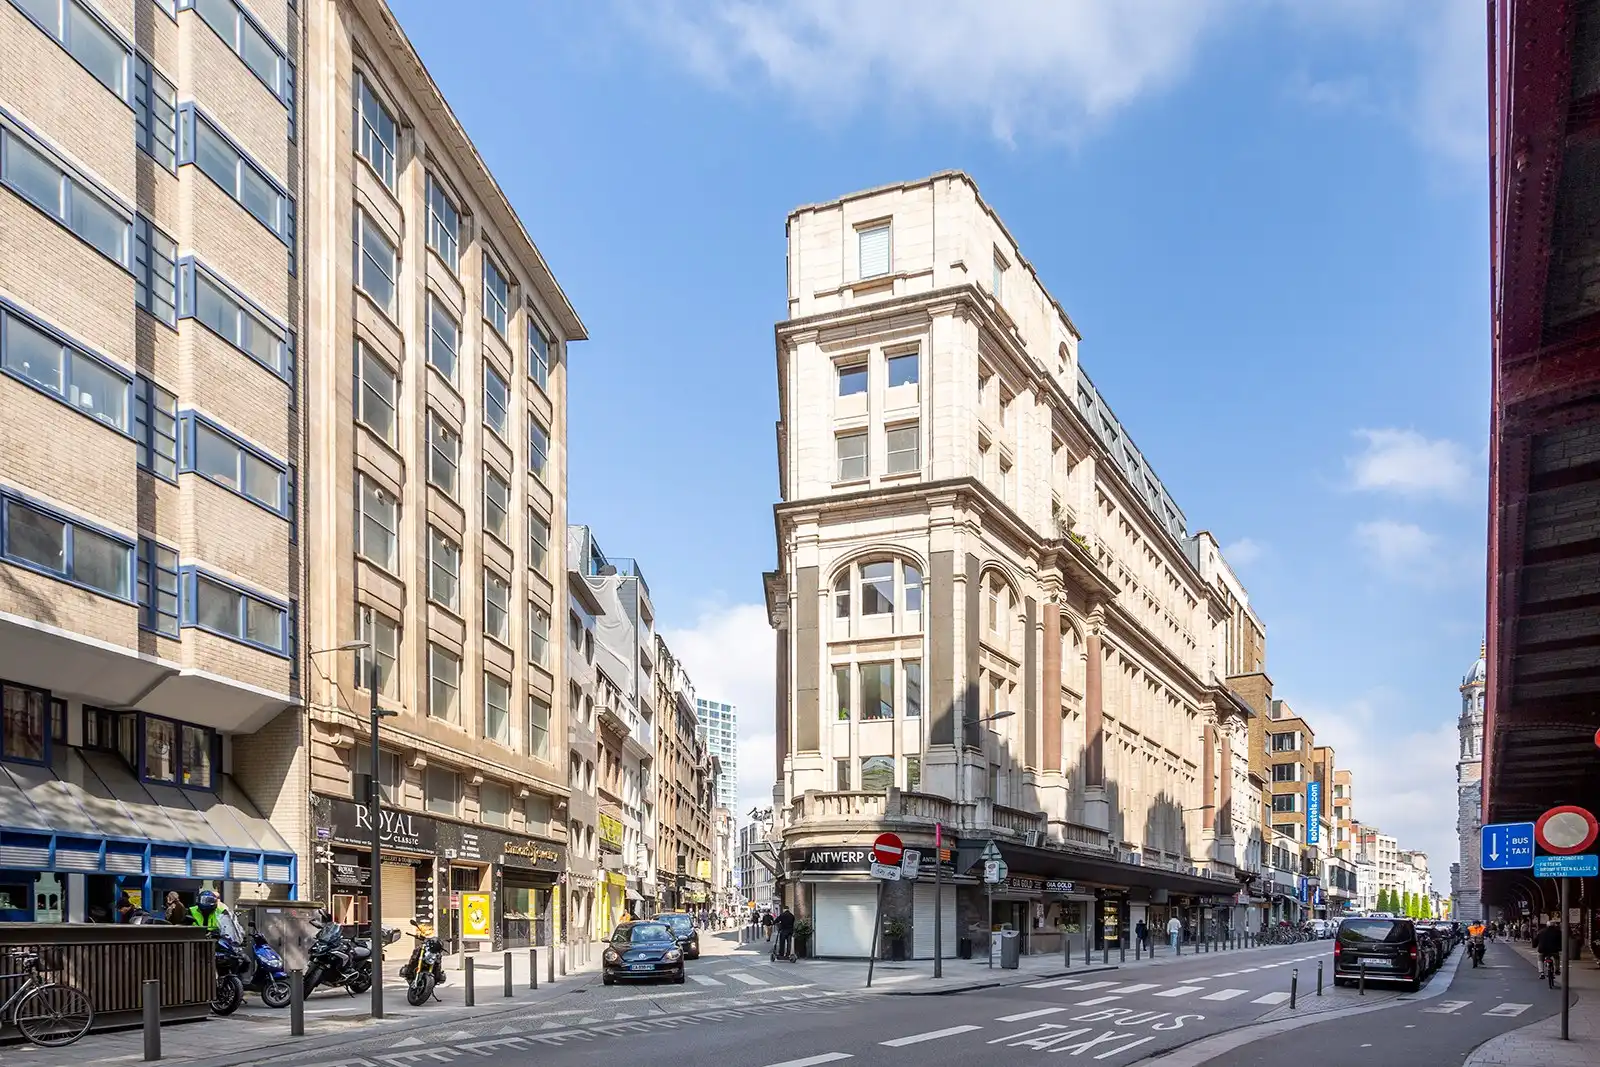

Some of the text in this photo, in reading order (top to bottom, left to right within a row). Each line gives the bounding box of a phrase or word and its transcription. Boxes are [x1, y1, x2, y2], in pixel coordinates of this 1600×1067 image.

[1308, 784, 1318, 841] aohostels.com
[393, 835, 419, 846] CLASSIC
[1511, 837, 1529, 845] BUS
[1511, 847, 1530, 855] TAXI
[809, 851, 864, 864] ANTWERP
[1020, 879, 1033, 889] GOLD
[1056, 881, 1072, 889] GOLD
[1069, 1007, 1206, 1031] BUS
[986, 1023, 1157, 1060] TAXI
